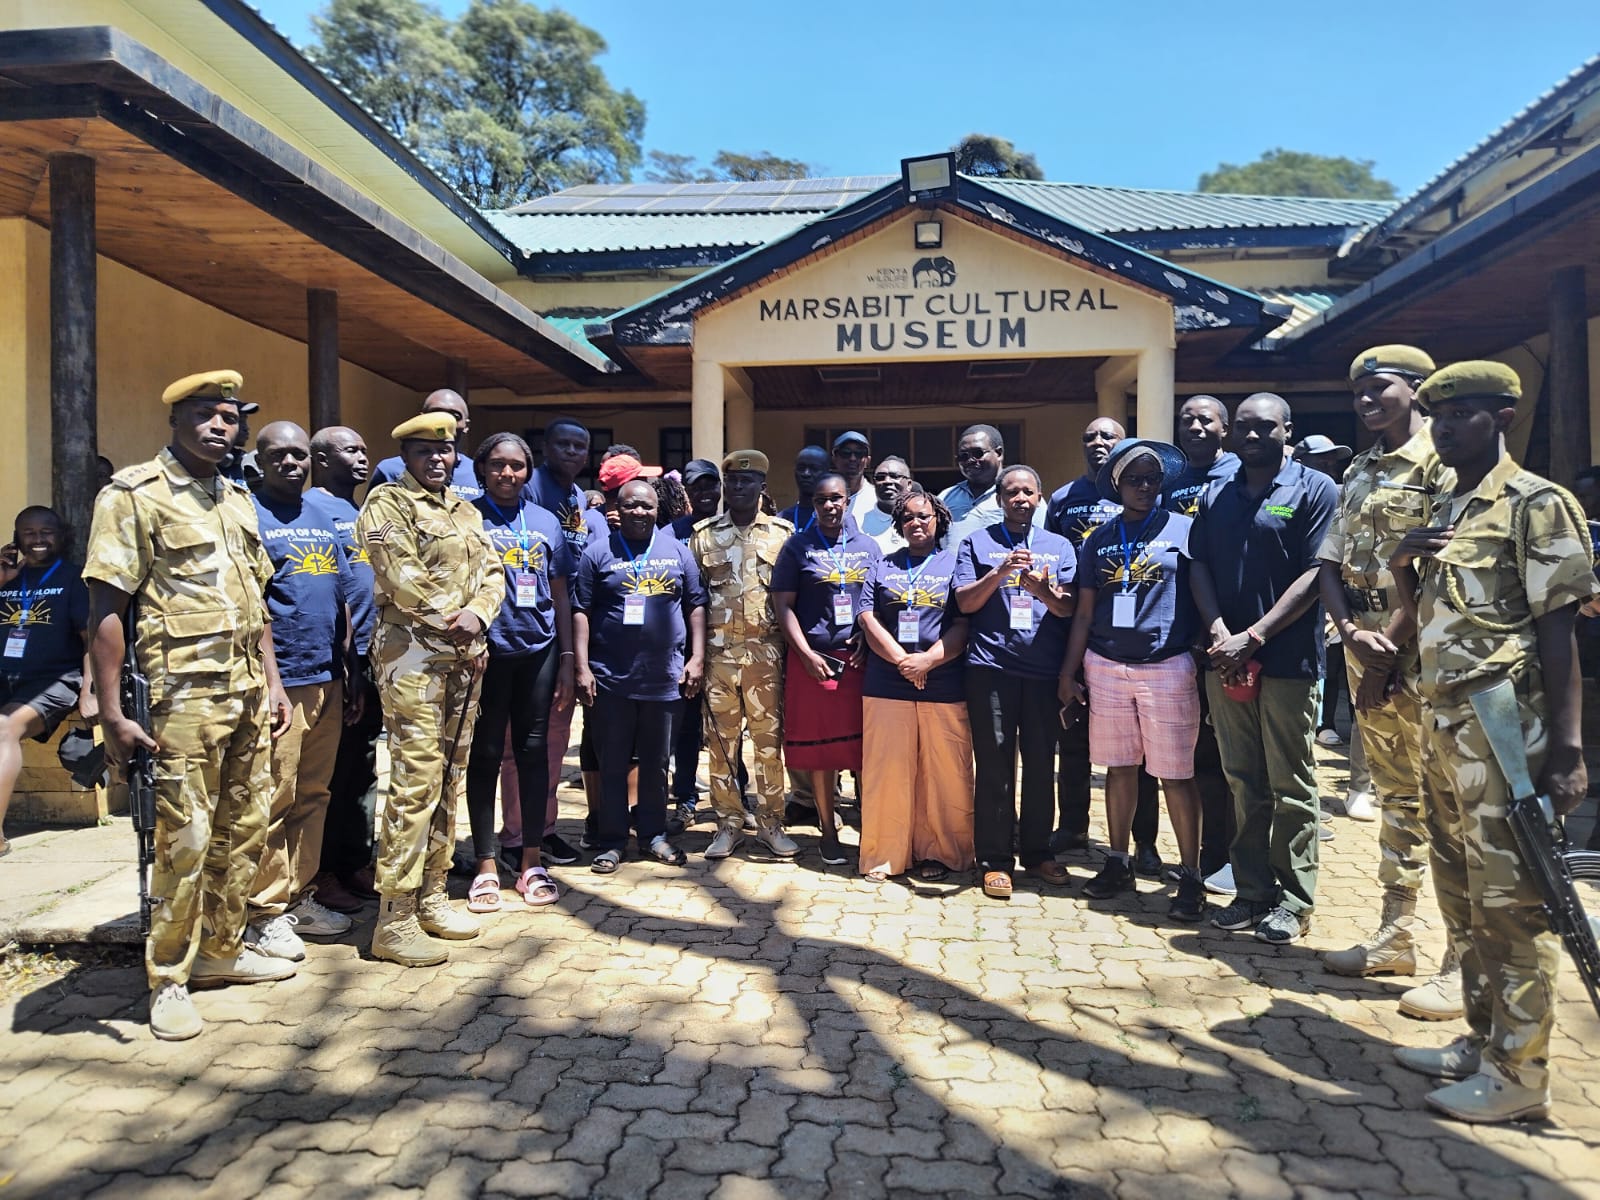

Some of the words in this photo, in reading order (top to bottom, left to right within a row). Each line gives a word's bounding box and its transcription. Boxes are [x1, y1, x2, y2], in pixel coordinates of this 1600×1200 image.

[759, 294, 914, 321] MARSABIT
[925, 288, 1118, 316] CULTURAL
[836, 316, 1027, 352] MUSEUM
[1170, 488, 1189, 499] HOPE
[1067, 505, 1088, 515] HOPE
[1089, 505, 1102, 513] OF
[265, 528, 295, 539] HOPE
[296, 528, 310, 536] OF
[1136, 540, 1173, 550] GLORY
